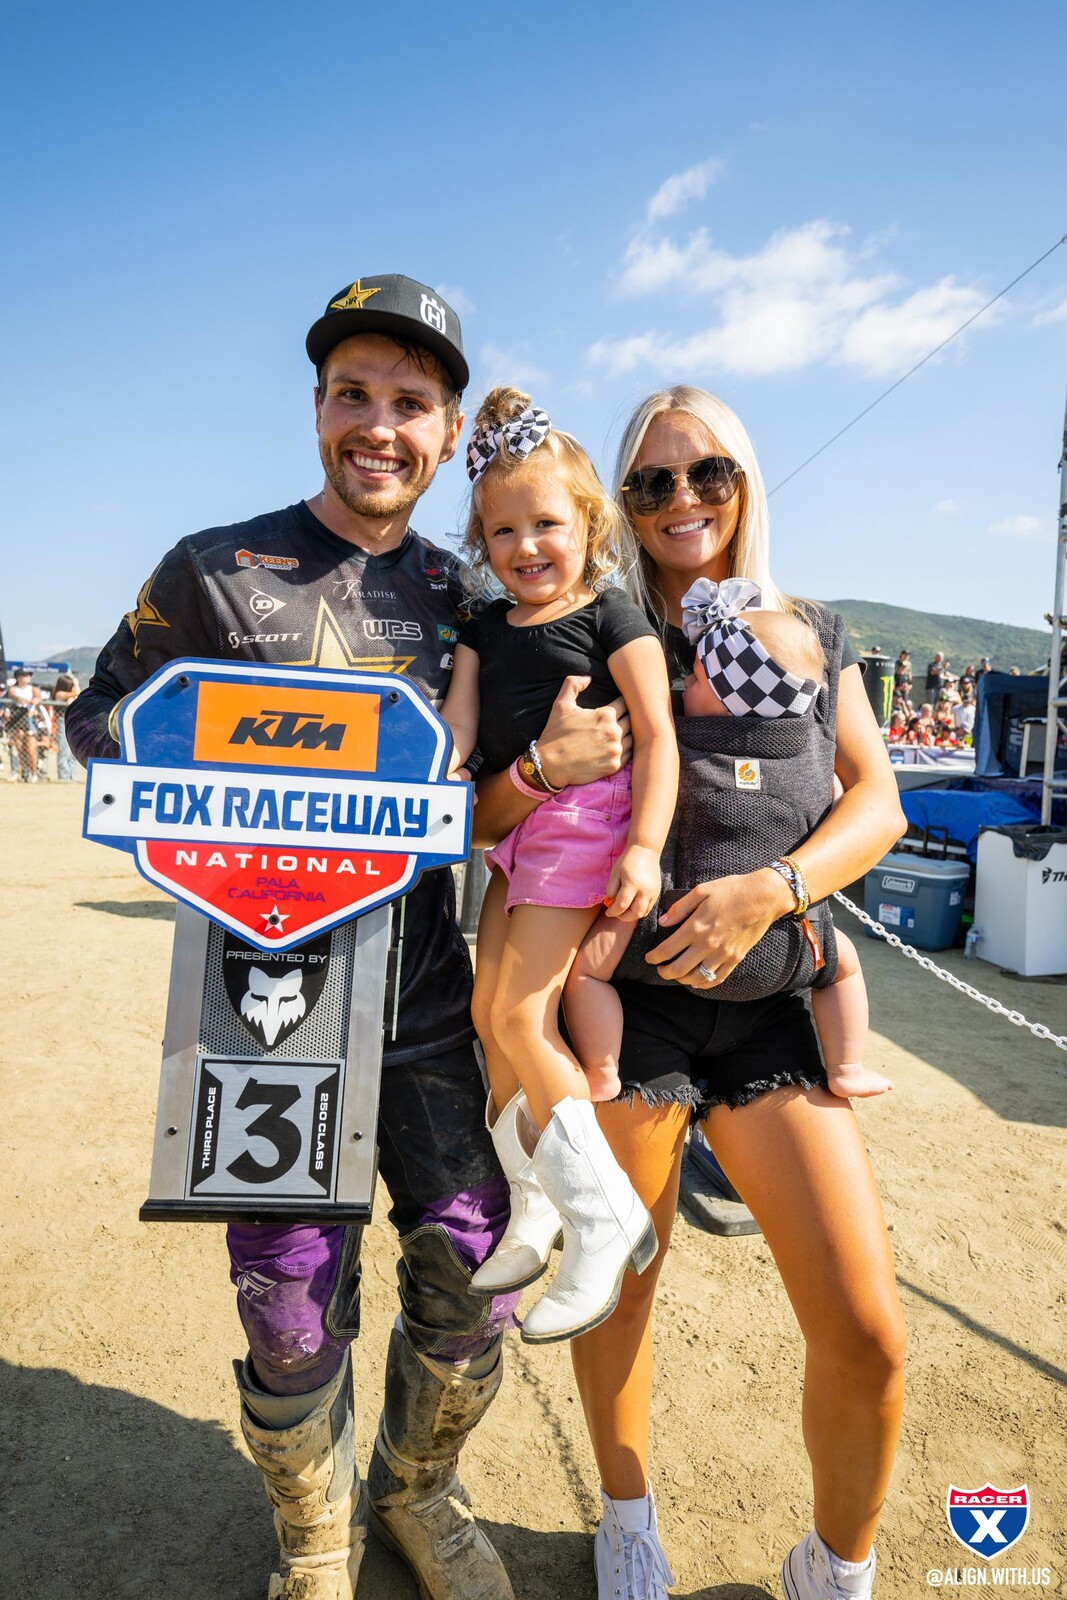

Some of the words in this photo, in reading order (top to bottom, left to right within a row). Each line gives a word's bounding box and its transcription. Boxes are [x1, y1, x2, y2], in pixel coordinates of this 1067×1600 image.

[258, 554, 299, 567] KEEN'S
[332, 579, 397, 600] PARADISE
[242, 632, 302, 644] SCOTT
[363, 619, 423, 641] WPS
[228, 710, 347, 751] KTM
[130, 781, 214, 825] FOX
[222, 786, 429, 838] RACEWAY
[175, 850, 381, 876] NATIONAL
[227, 887, 326, 902] CALIFORNIA
[256, 877, 299, 889] PALA
[226, 951, 304, 963] PRESENTED
[308, 954, 328, 964] BY
[206, 1087, 216, 1128] PLACE
[319, 1093, 329, 1120] 250
[225, 1077, 302, 1184] 3
[202, 1129, 213, 1170] THIRD
[315, 1122, 327, 1171] CLASS
